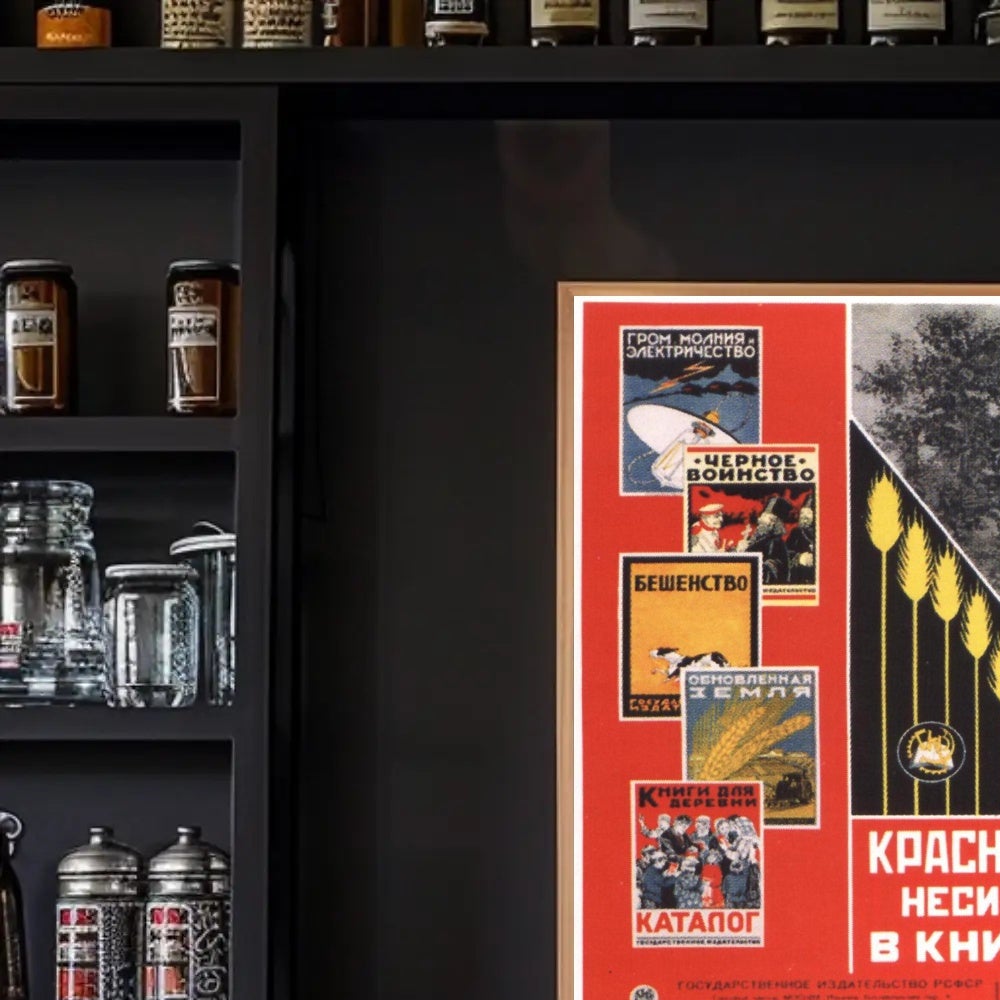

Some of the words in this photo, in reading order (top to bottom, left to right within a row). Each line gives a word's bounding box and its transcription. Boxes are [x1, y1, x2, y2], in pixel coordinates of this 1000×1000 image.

[680, 332, 745, 345] МОЛНИЯ
[626, 345, 756, 358] ЭЛЕКТРИЧЕСТВО
[704, 454, 796, 467] ЧЕРНОЕ
[686, 468, 815, 482] ВОИНСТВО
[634, 574, 748, 592] БЕШЕНСТВО
[687, 674, 813, 686] ОБНОВЛЕННАЯ
[689, 686, 811, 699] ЗЕМЛЯ
[717, 785, 755, 798] ДЛЯ
[669, 797, 757, 808] ДЕРЕВНИ
[901, 885, 1000, 917] НЕСИ
[636, 911, 760, 934] КАТАЛОГ
[869, 930, 900, 963] В
[676, 979, 811, 991] ГОСУДАРСТВЕННОЕ
[816, 979, 928, 991] ИЗДАТЕЛЬСТВО
